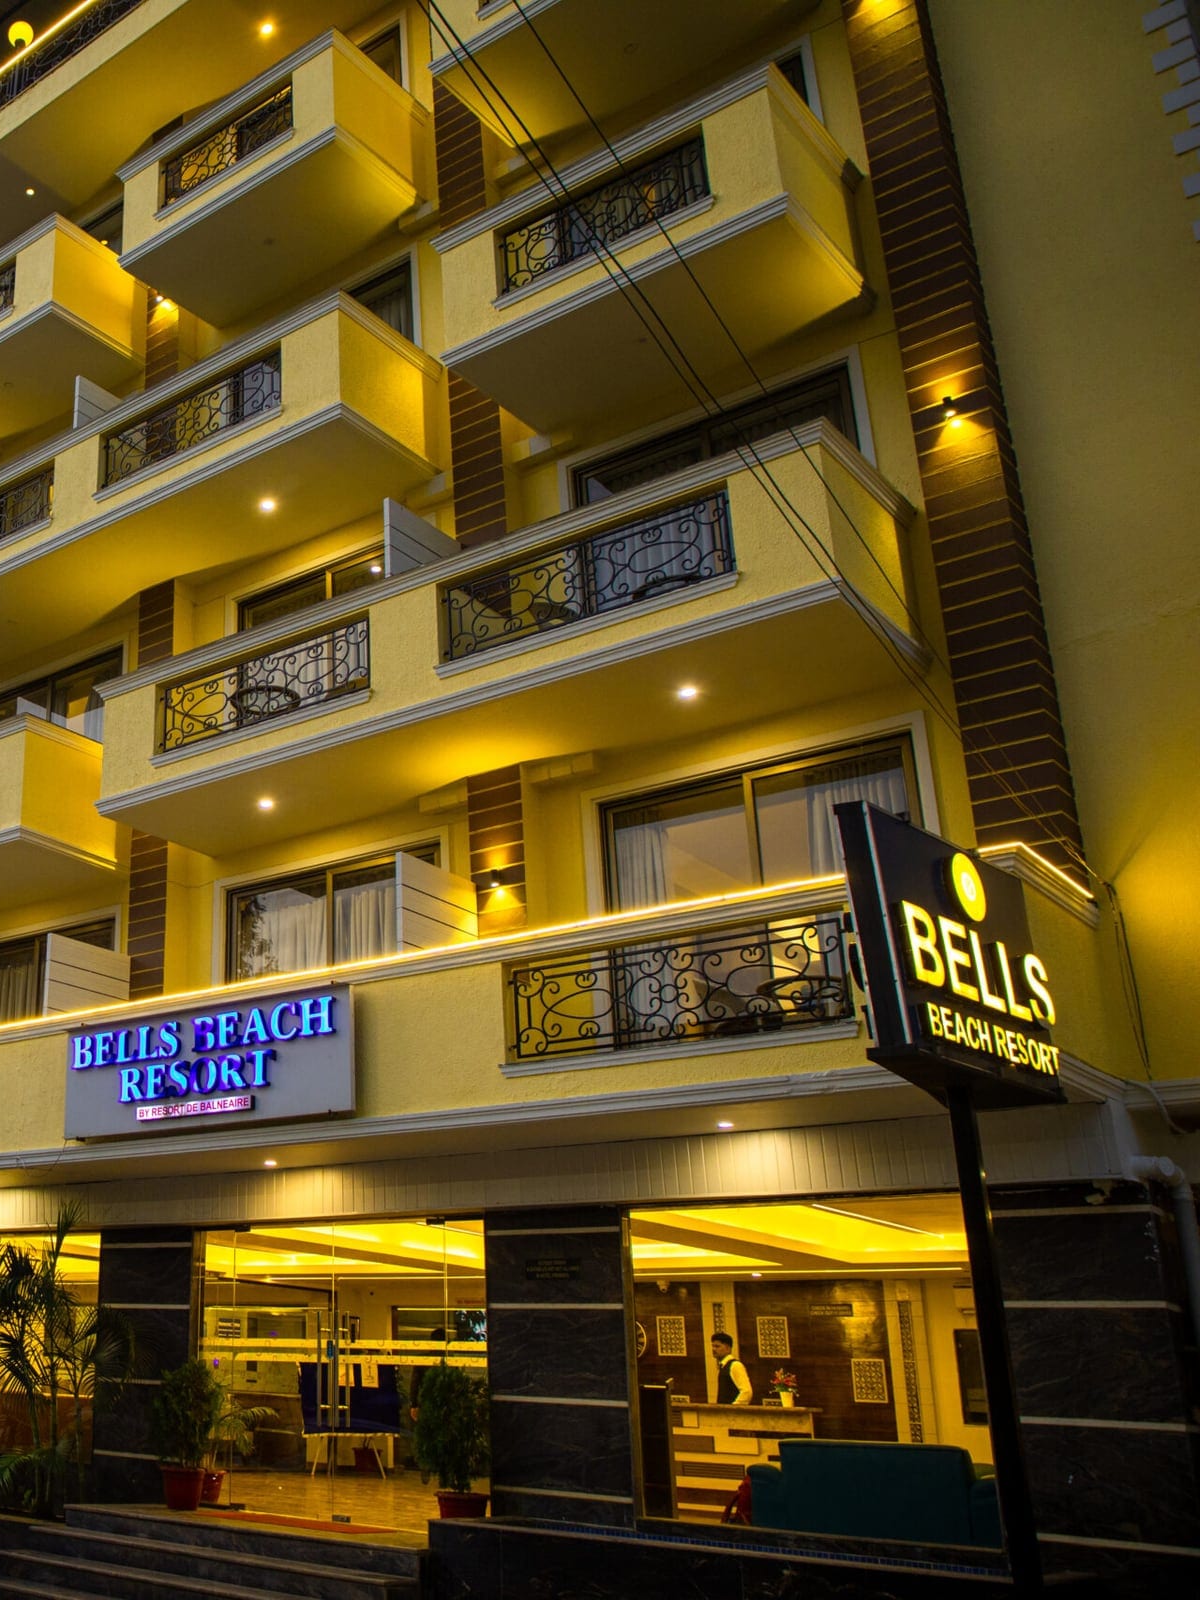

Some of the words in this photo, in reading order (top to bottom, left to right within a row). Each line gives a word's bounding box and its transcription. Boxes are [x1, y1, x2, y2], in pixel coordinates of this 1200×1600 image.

[902, 900, 1056, 1025] BELLS
[72, 1022, 179, 1069] BELLS
[192, 996, 335, 1052] BEACH
[927, 1002, 993, 1053] BEACH
[993, 1024, 1060, 1076] RESORT
[118, 1049, 275, 1102] RESORT
[138, 1108, 150, 1118] BY
[151, 1104, 185, 1117] RESORT
[186, 1103, 198, 1113] DE
[200, 1097, 249, 1112] BALNEAIRE
